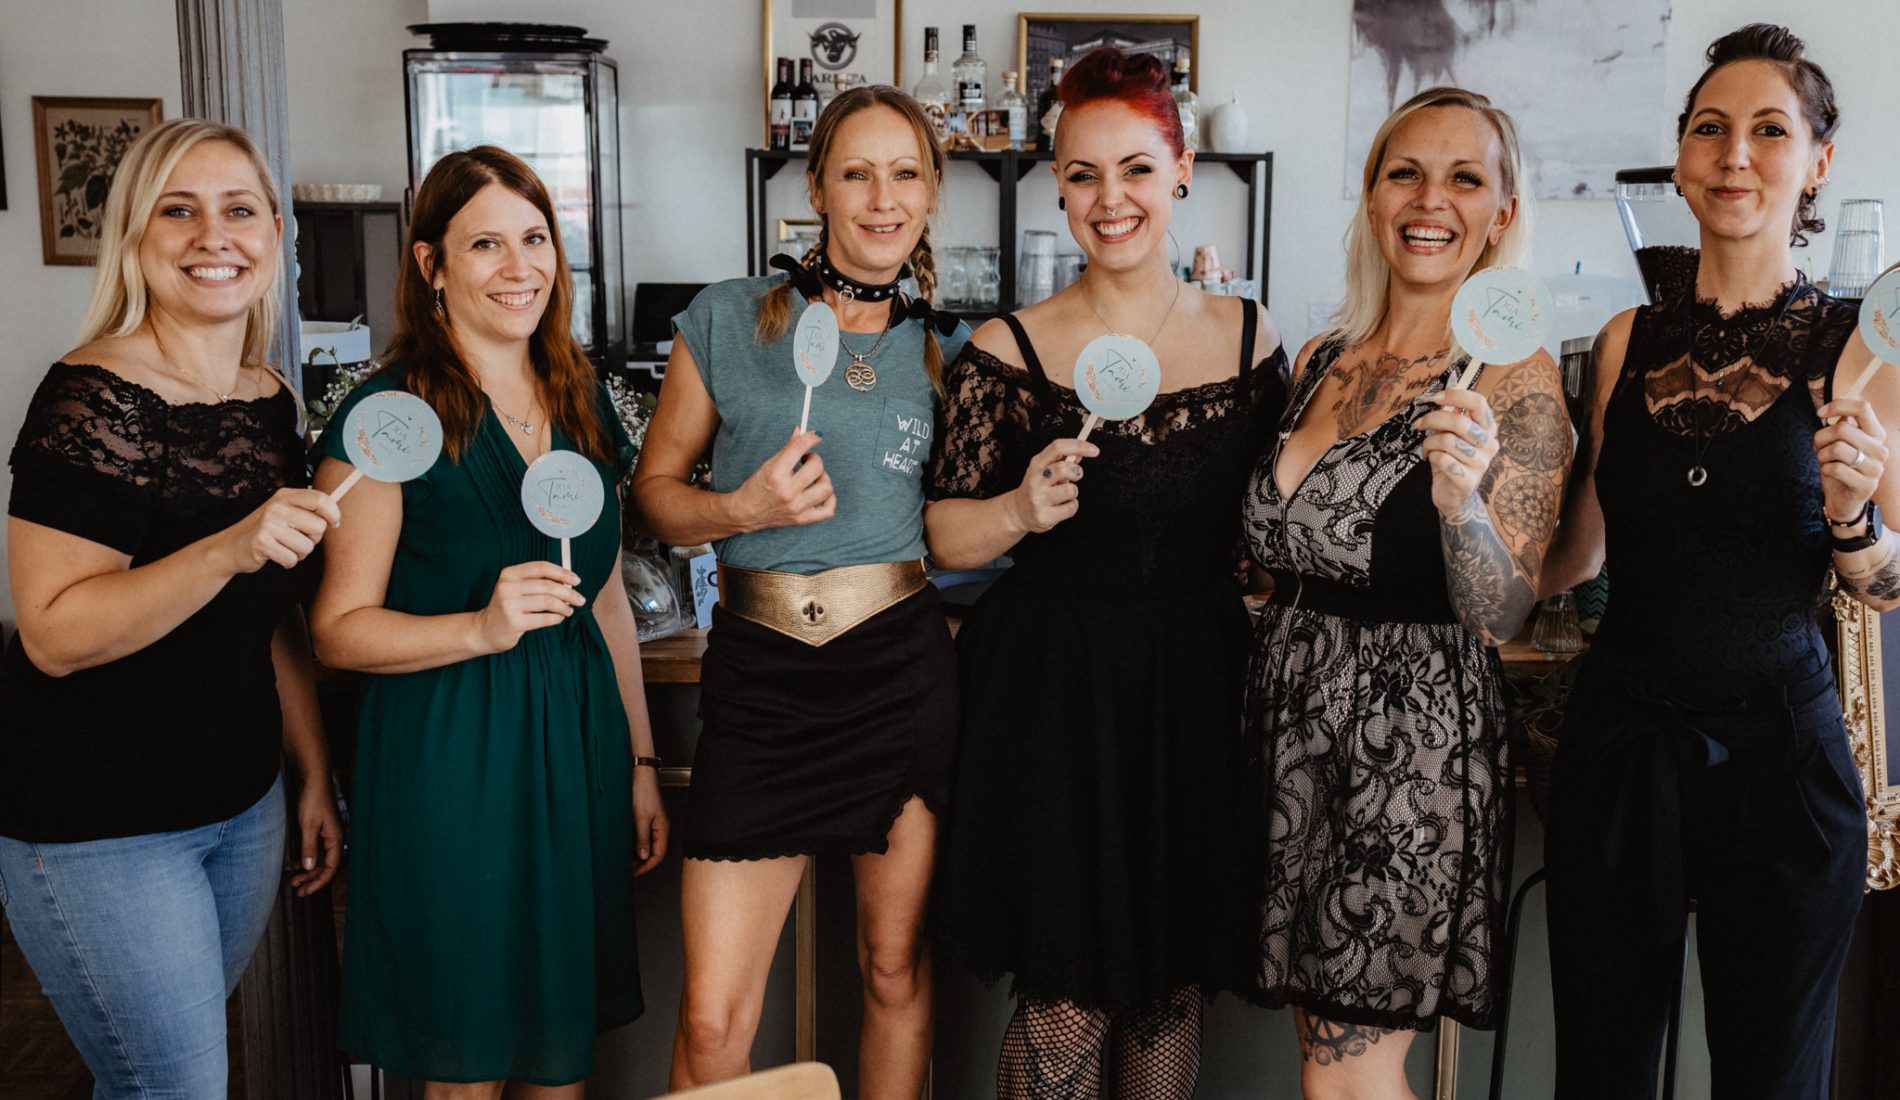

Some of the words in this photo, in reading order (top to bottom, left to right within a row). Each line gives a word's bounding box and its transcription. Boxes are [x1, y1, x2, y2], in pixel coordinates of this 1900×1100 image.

[896, 414, 930, 440] WILD
[899, 437, 921, 455] AT
[882, 451, 919, 475] HEART
